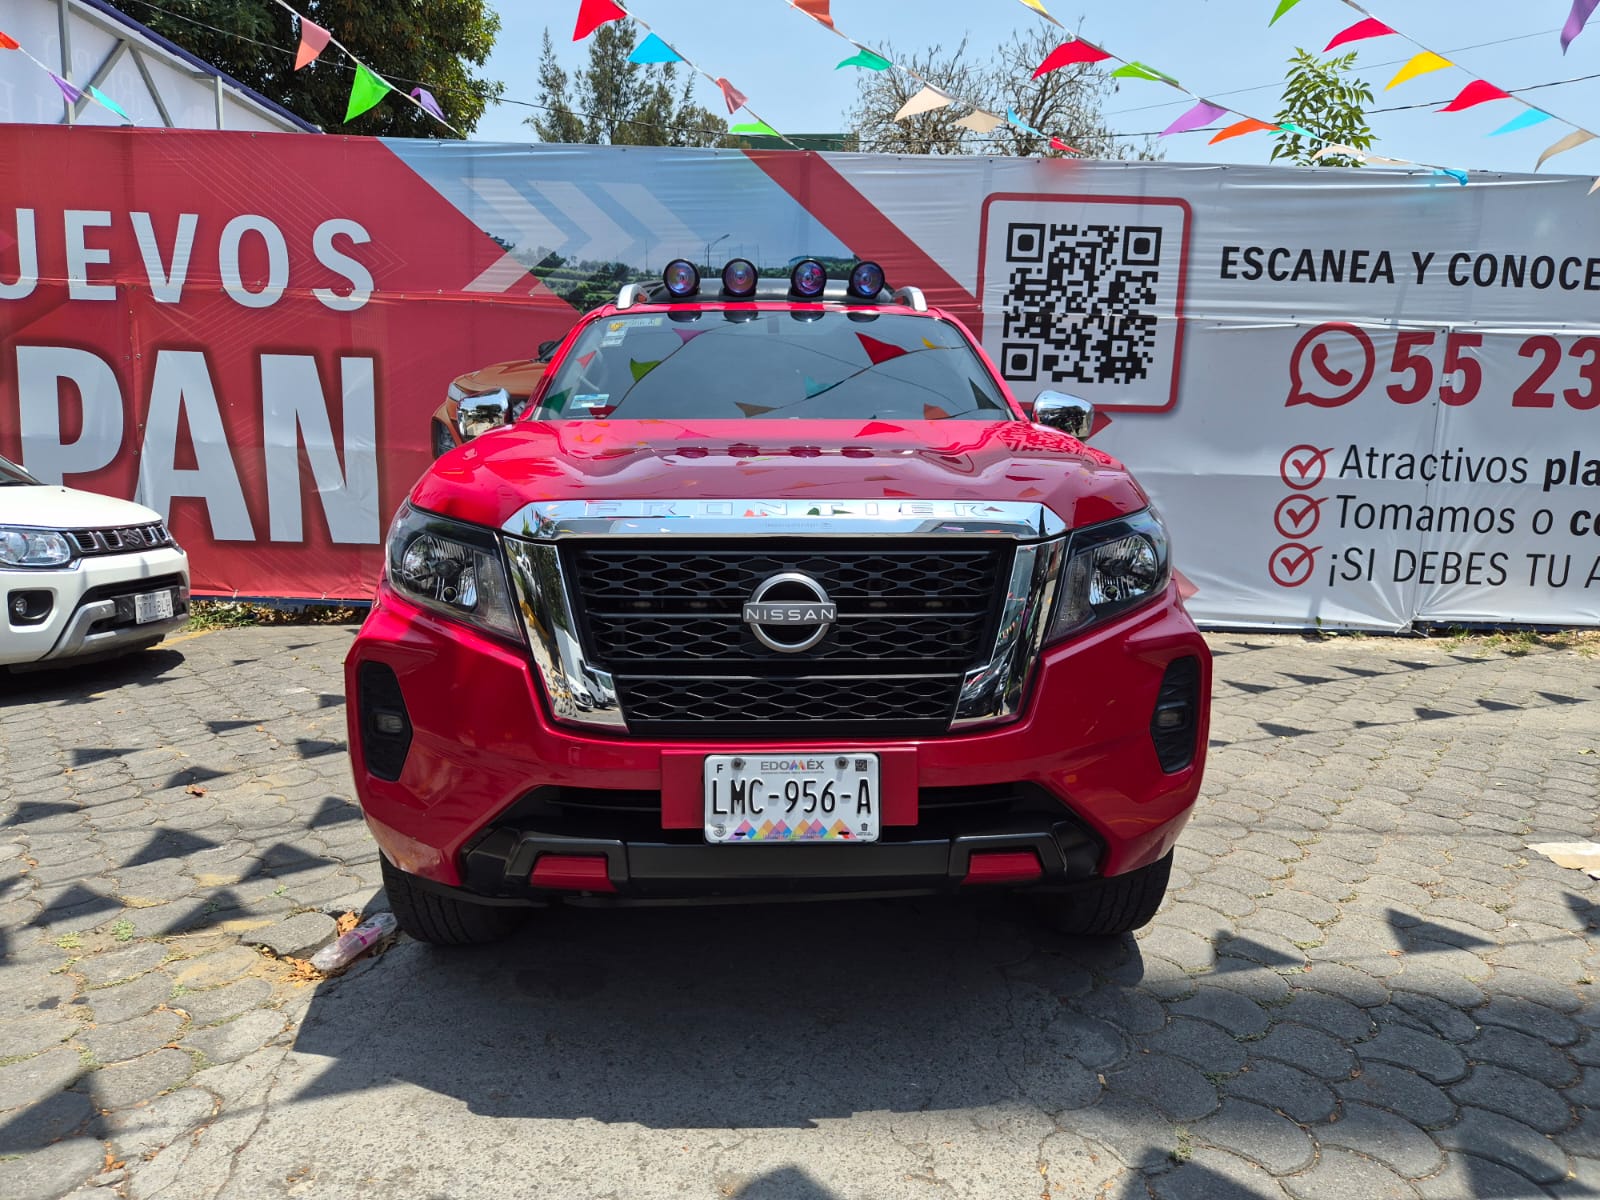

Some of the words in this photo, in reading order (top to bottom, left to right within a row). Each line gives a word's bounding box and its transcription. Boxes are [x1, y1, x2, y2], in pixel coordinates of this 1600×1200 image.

[1220, 246, 1395, 284] ESCANEA
[1411, 251, 1436, 285] Y
[1447, 252, 1600, 291] CONOCE
[1386, 331, 1483, 407] 55
[1511, 334, 1600, 411] 23
[15, 344, 381, 545] PAN
[1339, 444, 1529, 484] Atractivos
[1543, 450, 1600, 492] pla
[584, 501, 990, 516] FRONTIER
[1336, 494, 1516, 535] Tomamos
[1532, 508, 1554, 535] o
[1569, 510, 1600, 537] c
[1328, 547, 1376, 587] ¡SI
[1393, 549, 1509, 587] DEBES
[1526, 553, 1571, 588] TU
[746, 608, 834, 621] NISSAN
[716, 763, 724, 774] F
[712, 778, 872, 815] LMC-956-A
